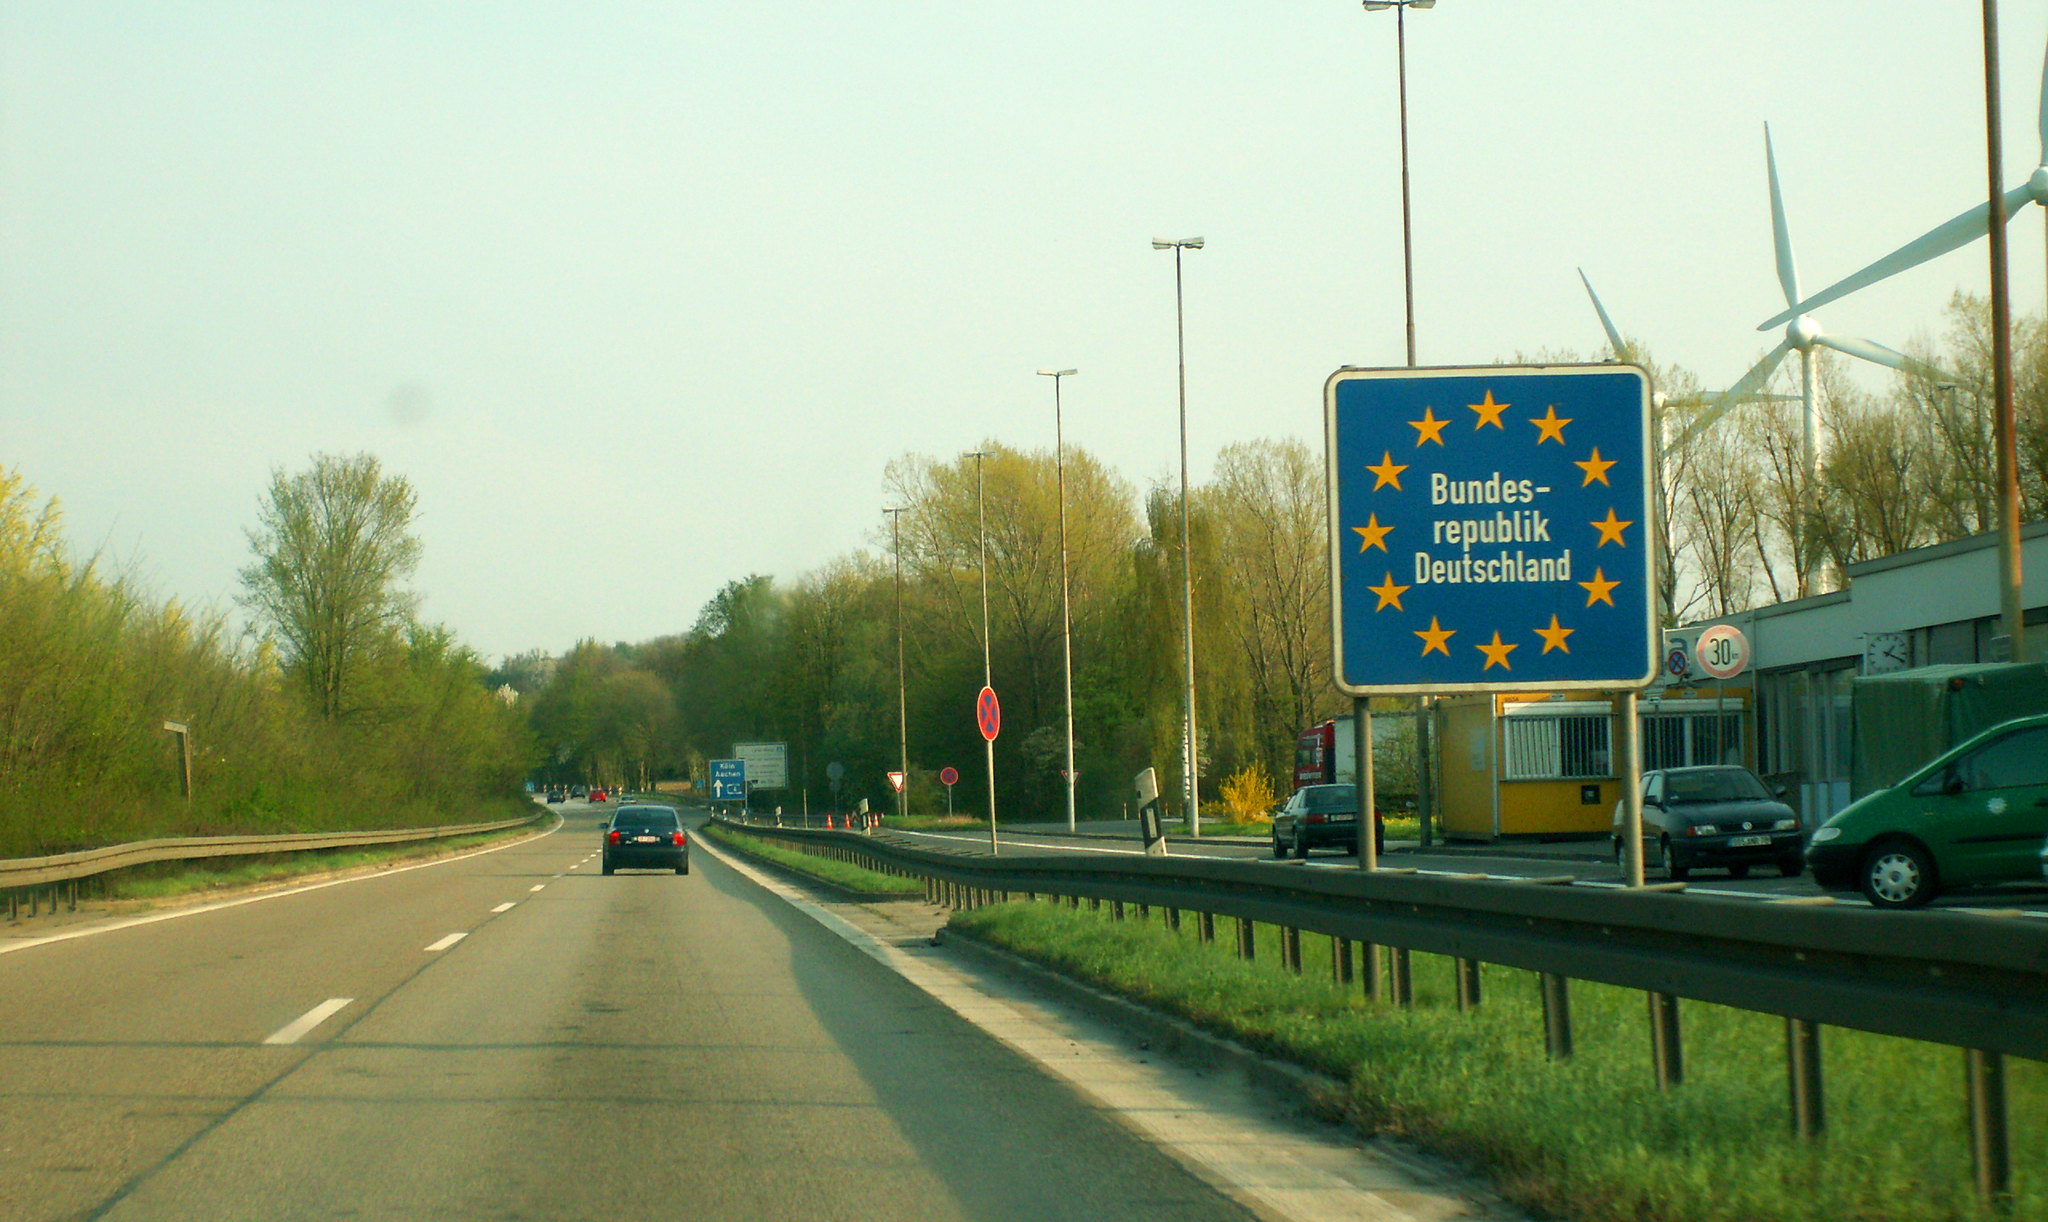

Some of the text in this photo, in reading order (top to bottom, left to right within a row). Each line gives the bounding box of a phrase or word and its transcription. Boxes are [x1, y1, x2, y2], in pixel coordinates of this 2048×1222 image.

[1431, 472, 1551, 505] Bundes-
[1433, 510, 1551, 552] republik
[1415, 549, 1571, 584] Deutschland
[1709, 638, 1731, 666] 30
